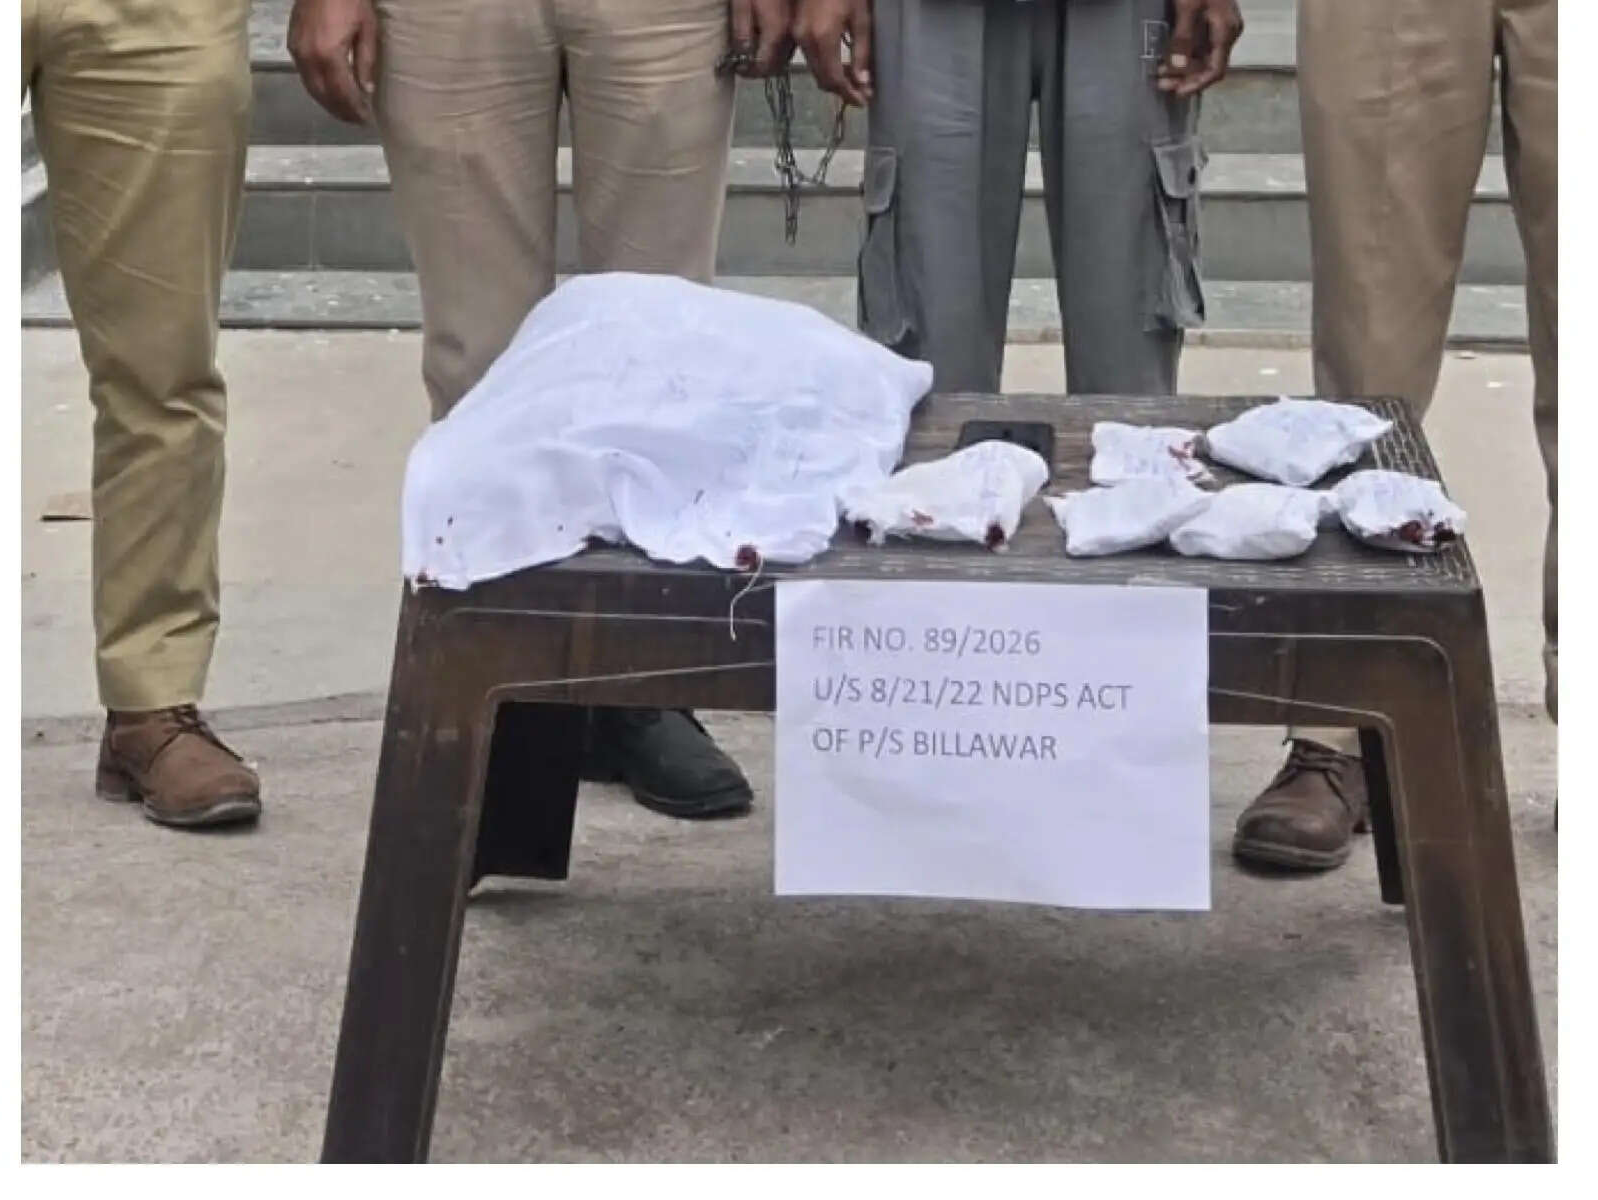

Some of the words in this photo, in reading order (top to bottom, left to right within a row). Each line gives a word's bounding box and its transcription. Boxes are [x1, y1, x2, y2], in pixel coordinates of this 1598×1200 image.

[812, 626, 854, 651] FIR
[863, 627, 914, 652] NO.
[924, 627, 1042, 657] 89/2026
[813, 674, 862, 705] U/S
[870, 678, 983, 709] 8/21/22
[994, 681, 1068, 709] NDPS
[1077, 684, 1134, 711] ACT
[812, 728, 850, 753] OF
[859, 727, 904, 759] P/S
[914, 730, 1057, 760] BILLAWAR
